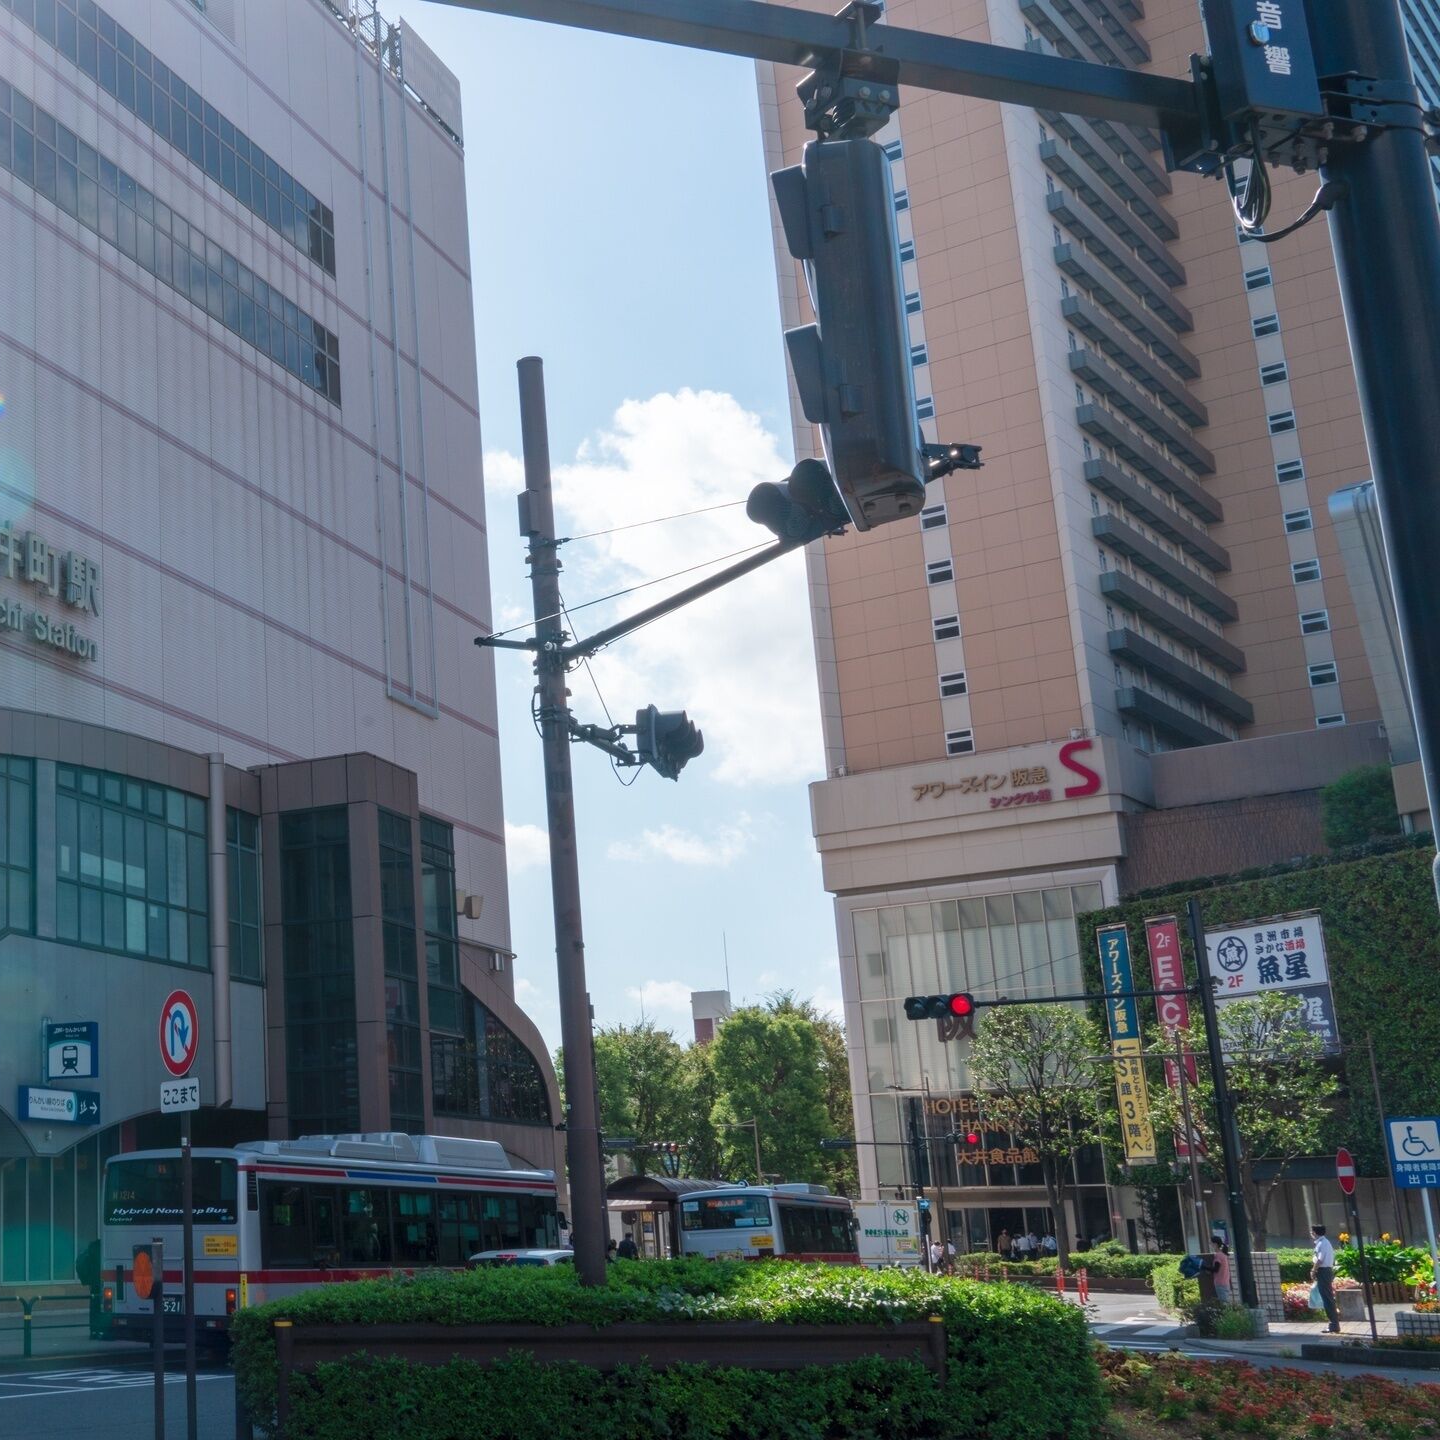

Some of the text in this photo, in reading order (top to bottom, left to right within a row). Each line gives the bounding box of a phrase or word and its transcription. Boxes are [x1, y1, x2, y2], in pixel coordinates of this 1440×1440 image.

[33, 611, 98, 662] Station
[912, 766, 1049, 801] アワーズイン 阪急
[1155, 932, 1171, 949] 2F
[1257, 951, 1311, 985] 魚星
[1227, 975, 1244, 988] 2F
[163, 1086, 197, 1105] ここまで
[925, 1098, 979, 1114] HOTEL
[958, 1147, 1040, 1165] 大井食品館
[1396, 1162, 1440, 1173] 身障者乗降
[1408, 1174, 1437, 1185] 出口
[113, 1206, 228, 1215] Hybrid Nonsop Bus
